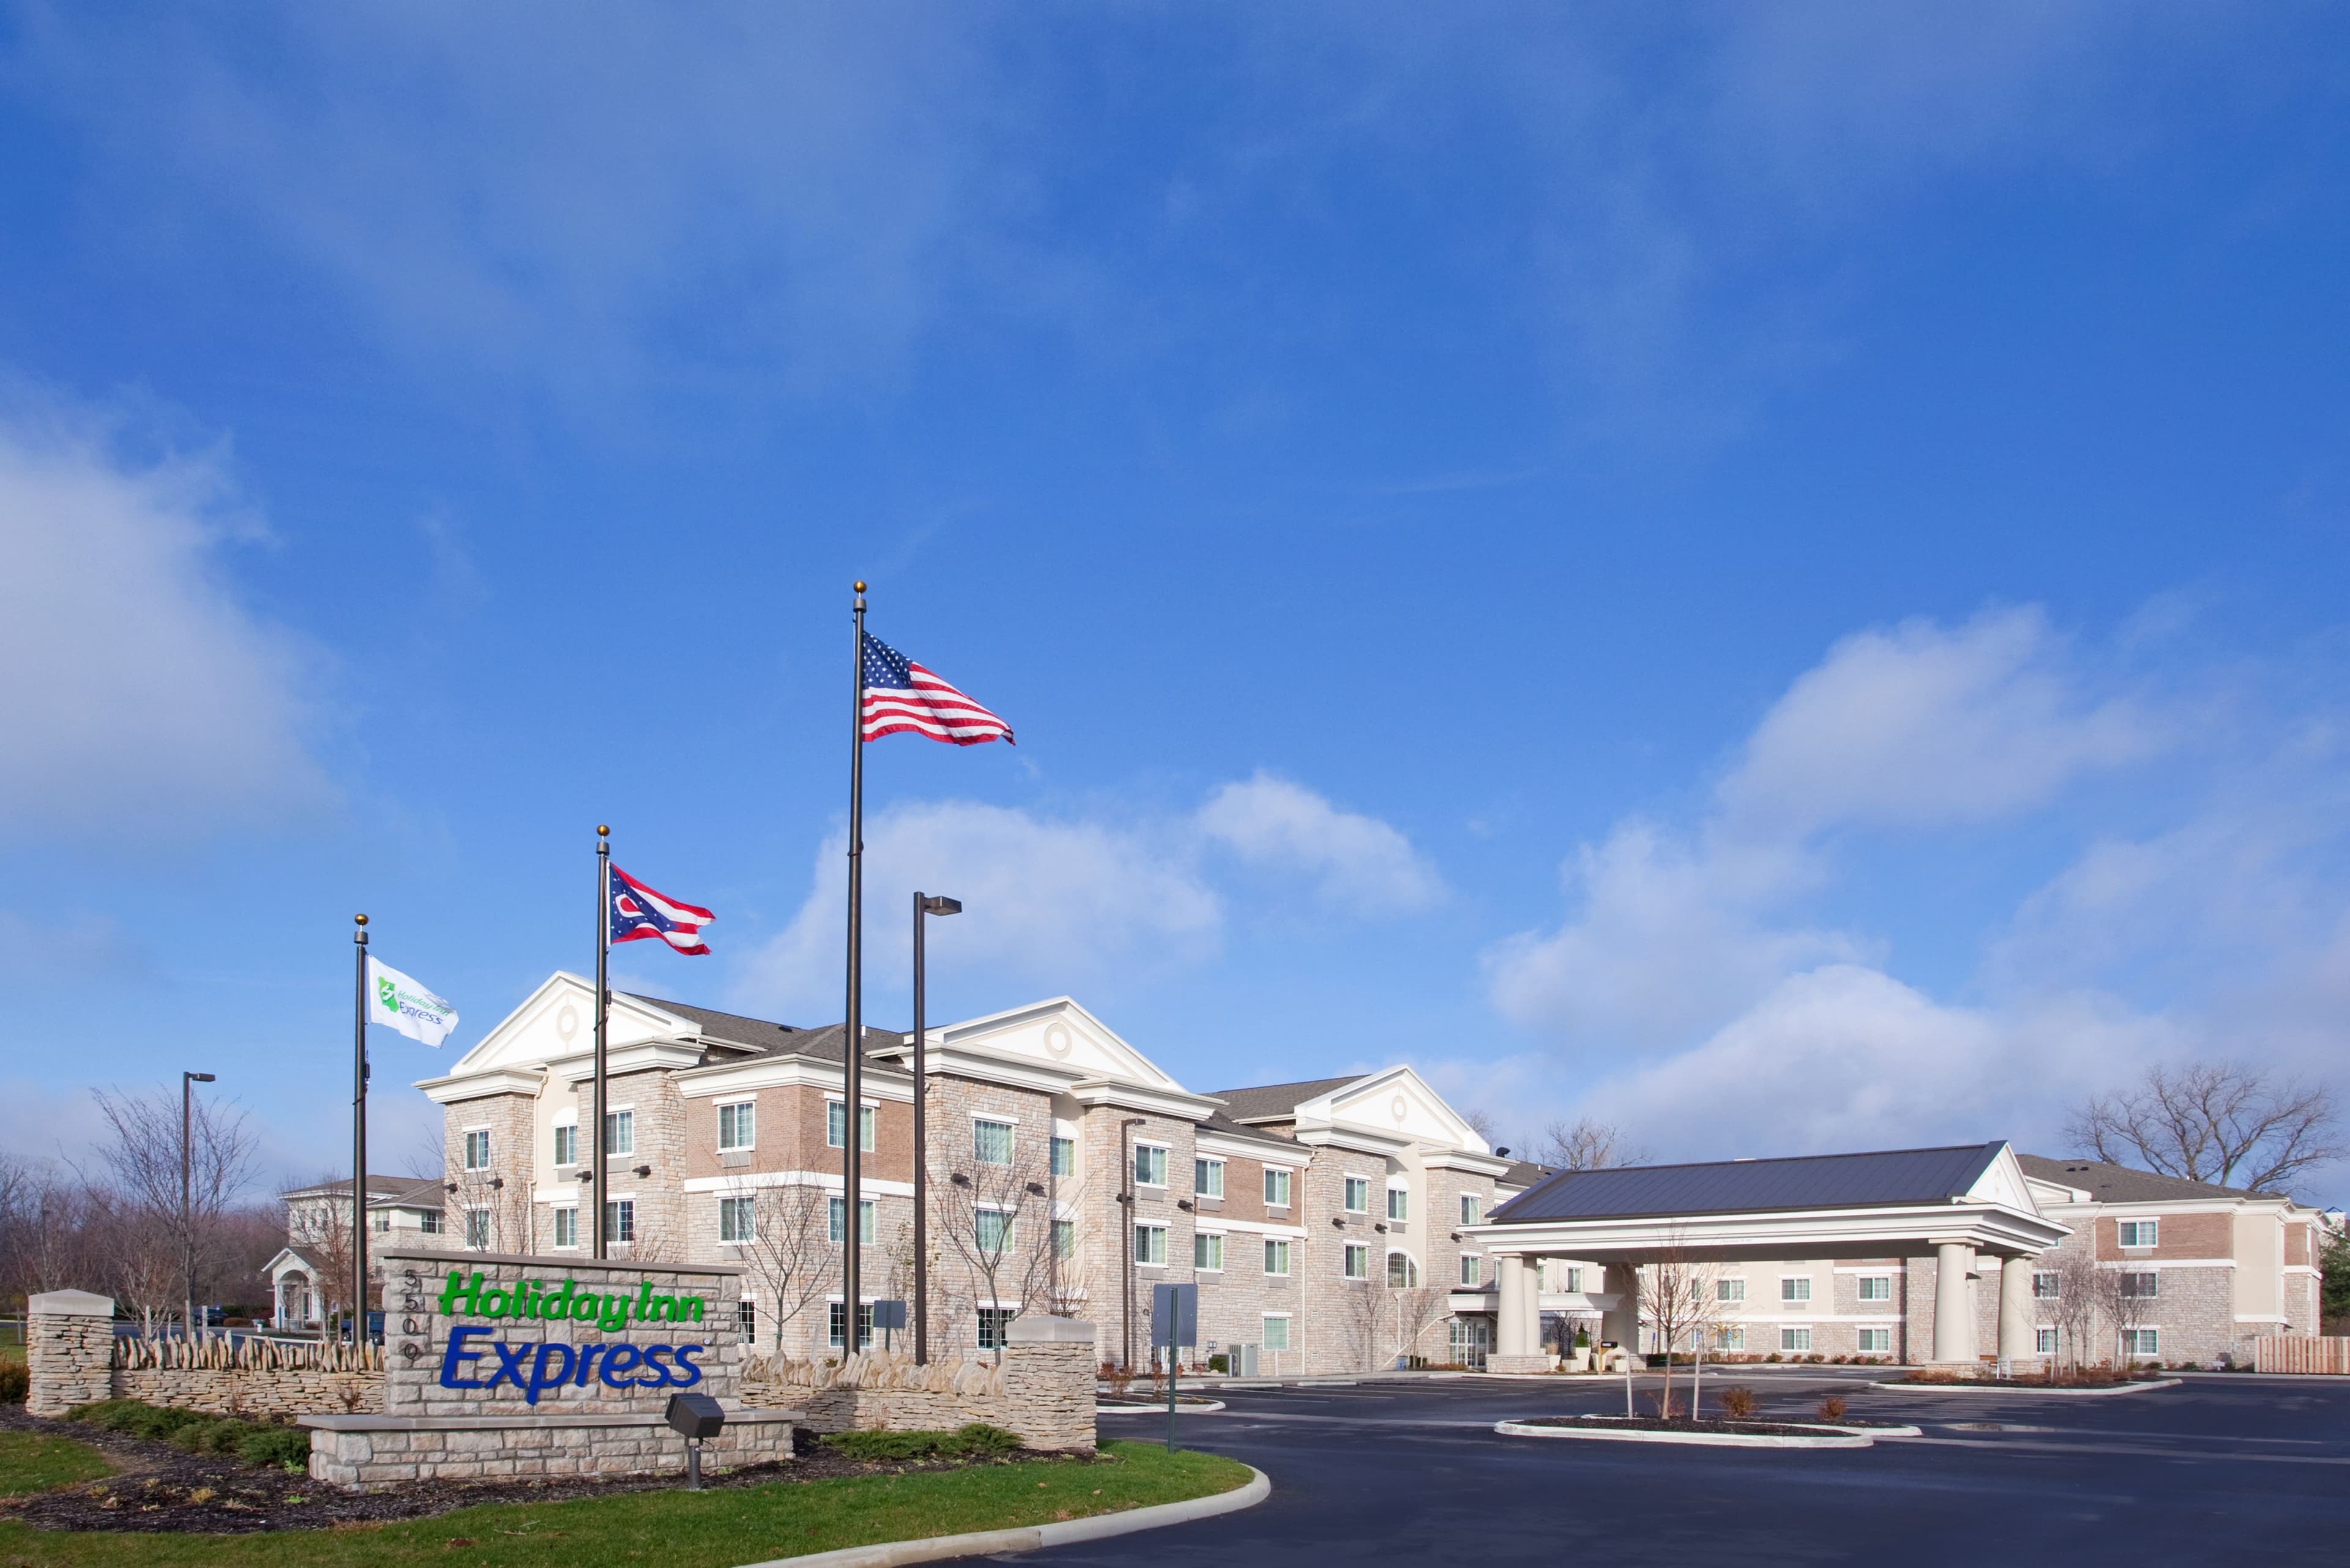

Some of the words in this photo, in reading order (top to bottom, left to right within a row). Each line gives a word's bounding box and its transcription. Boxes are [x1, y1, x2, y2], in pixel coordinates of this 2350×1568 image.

[398, 991, 432, 1009] Holiday
[433, 1005, 450, 1017] Inn
[437, 1271, 630, 1332] Holiday
[635, 1280, 703, 1323] Inn
[439, 1326, 703, 1405] Express
